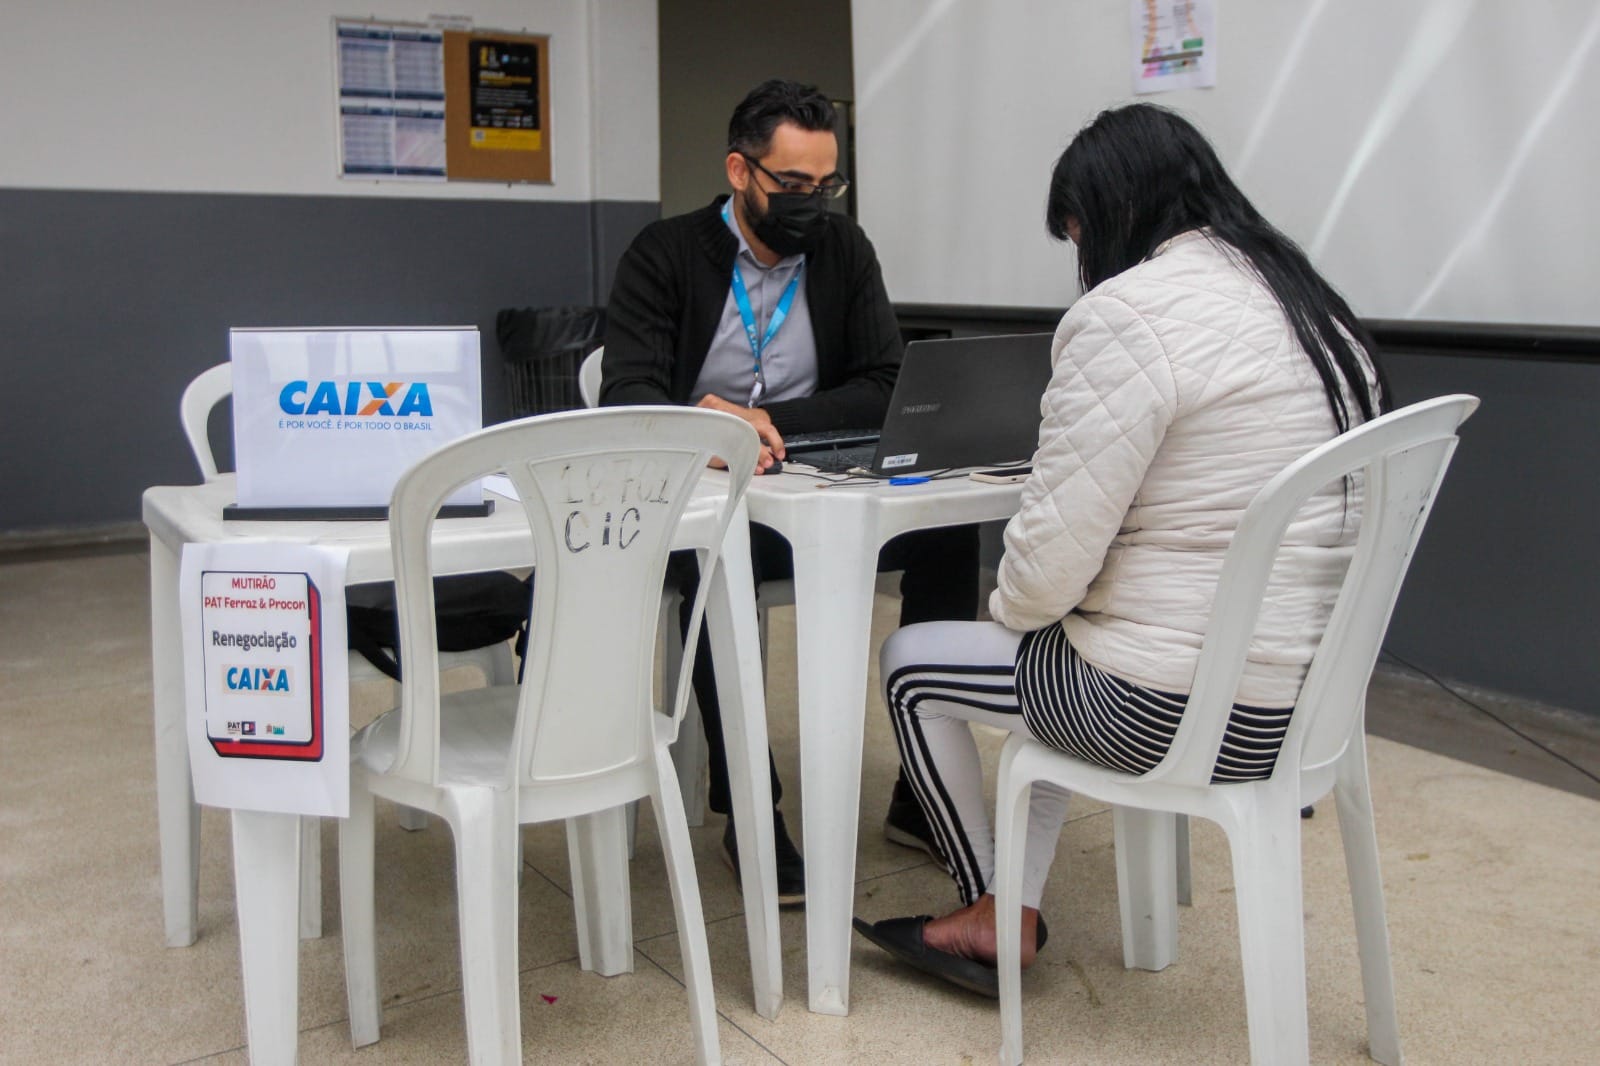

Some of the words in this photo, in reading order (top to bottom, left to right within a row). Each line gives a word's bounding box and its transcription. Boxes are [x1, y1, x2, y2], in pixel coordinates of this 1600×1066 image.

[279, 380, 433, 416] CAIXA
[279, 420, 284, 429] É
[286, 421, 304, 429] POR
[337, 420, 342, 429] É
[344, 421, 362, 430] POR
[365, 422, 391, 430] TODO
[394, 422, 401, 430] O
[403, 422, 432, 430] BRASIL
[231, 575, 276, 590] MUTIRÃO
[204, 597, 221, 608] PAT
[224, 597, 257, 609] Ferraz
[259, 598, 267, 609] &
[269, 598, 306, 610] Procon
[212, 630, 297, 652] Renegociação
[227, 667, 290, 692] CAIXA
